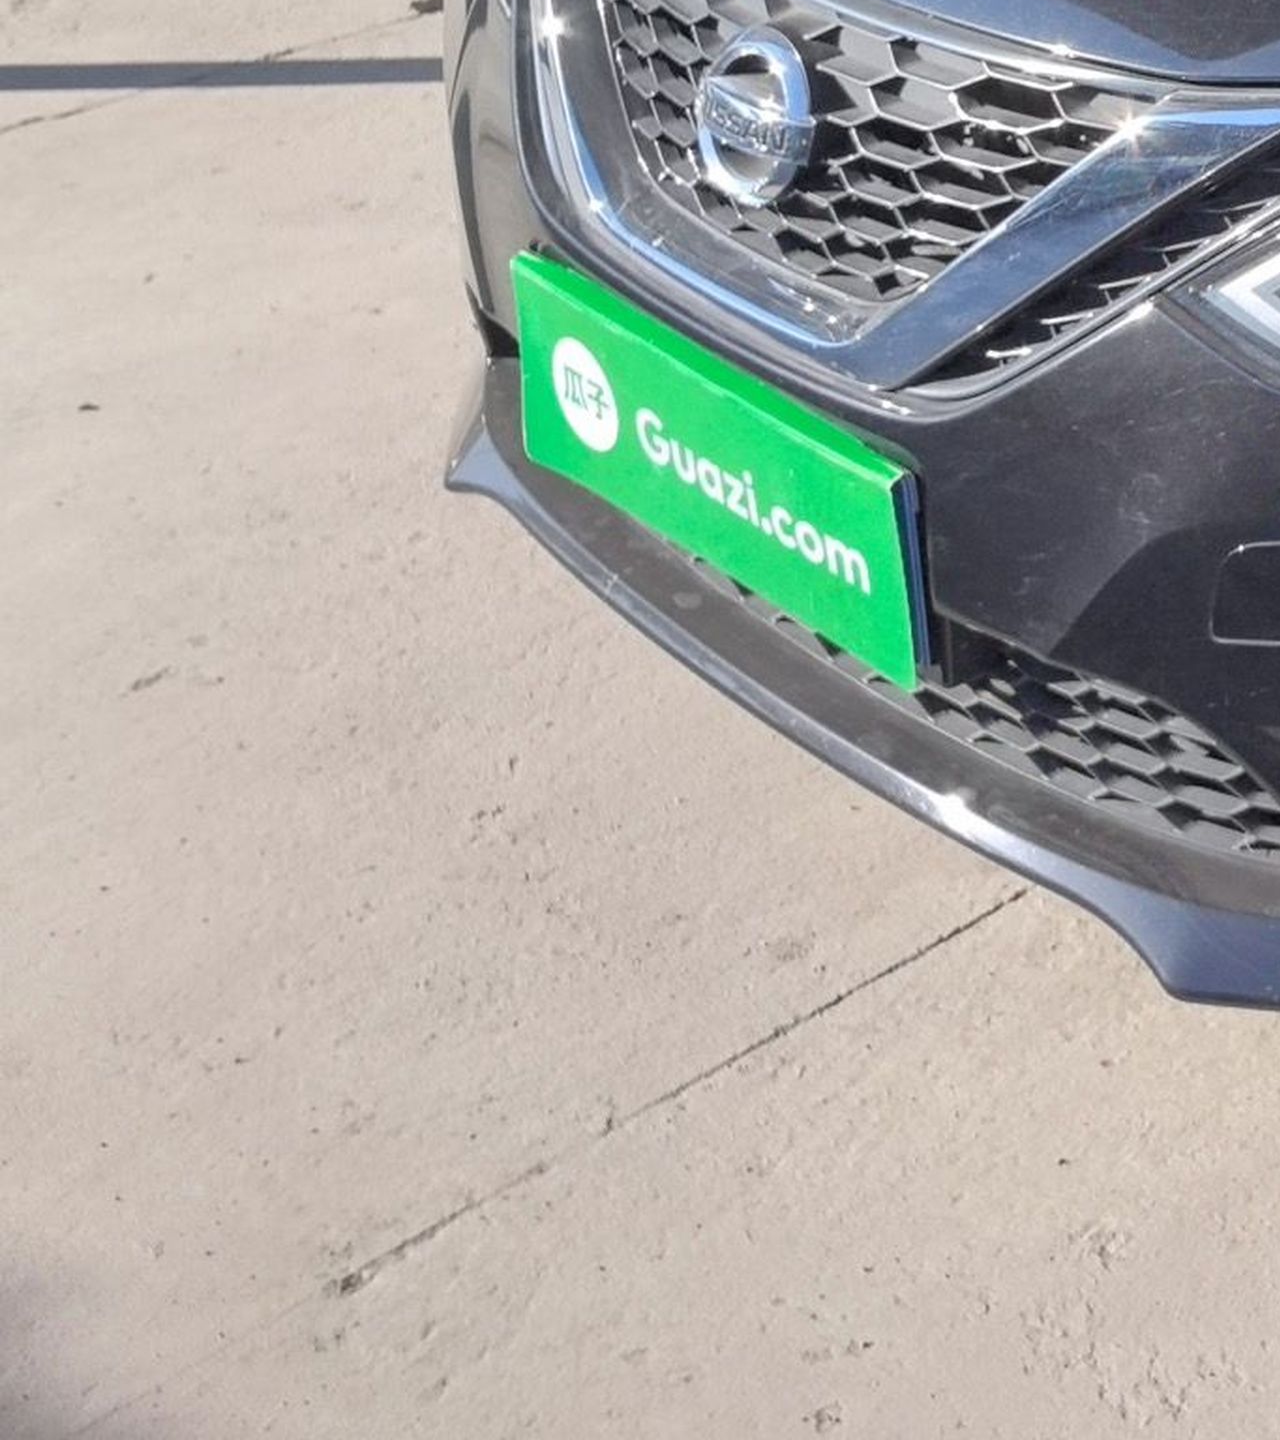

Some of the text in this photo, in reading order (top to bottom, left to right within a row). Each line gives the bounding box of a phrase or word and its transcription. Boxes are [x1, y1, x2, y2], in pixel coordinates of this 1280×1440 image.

[703, 88, 788, 155] NISSAN
[563, 364, 610, 421] 瓜子
[636, 407, 871, 596] Guazi.com
